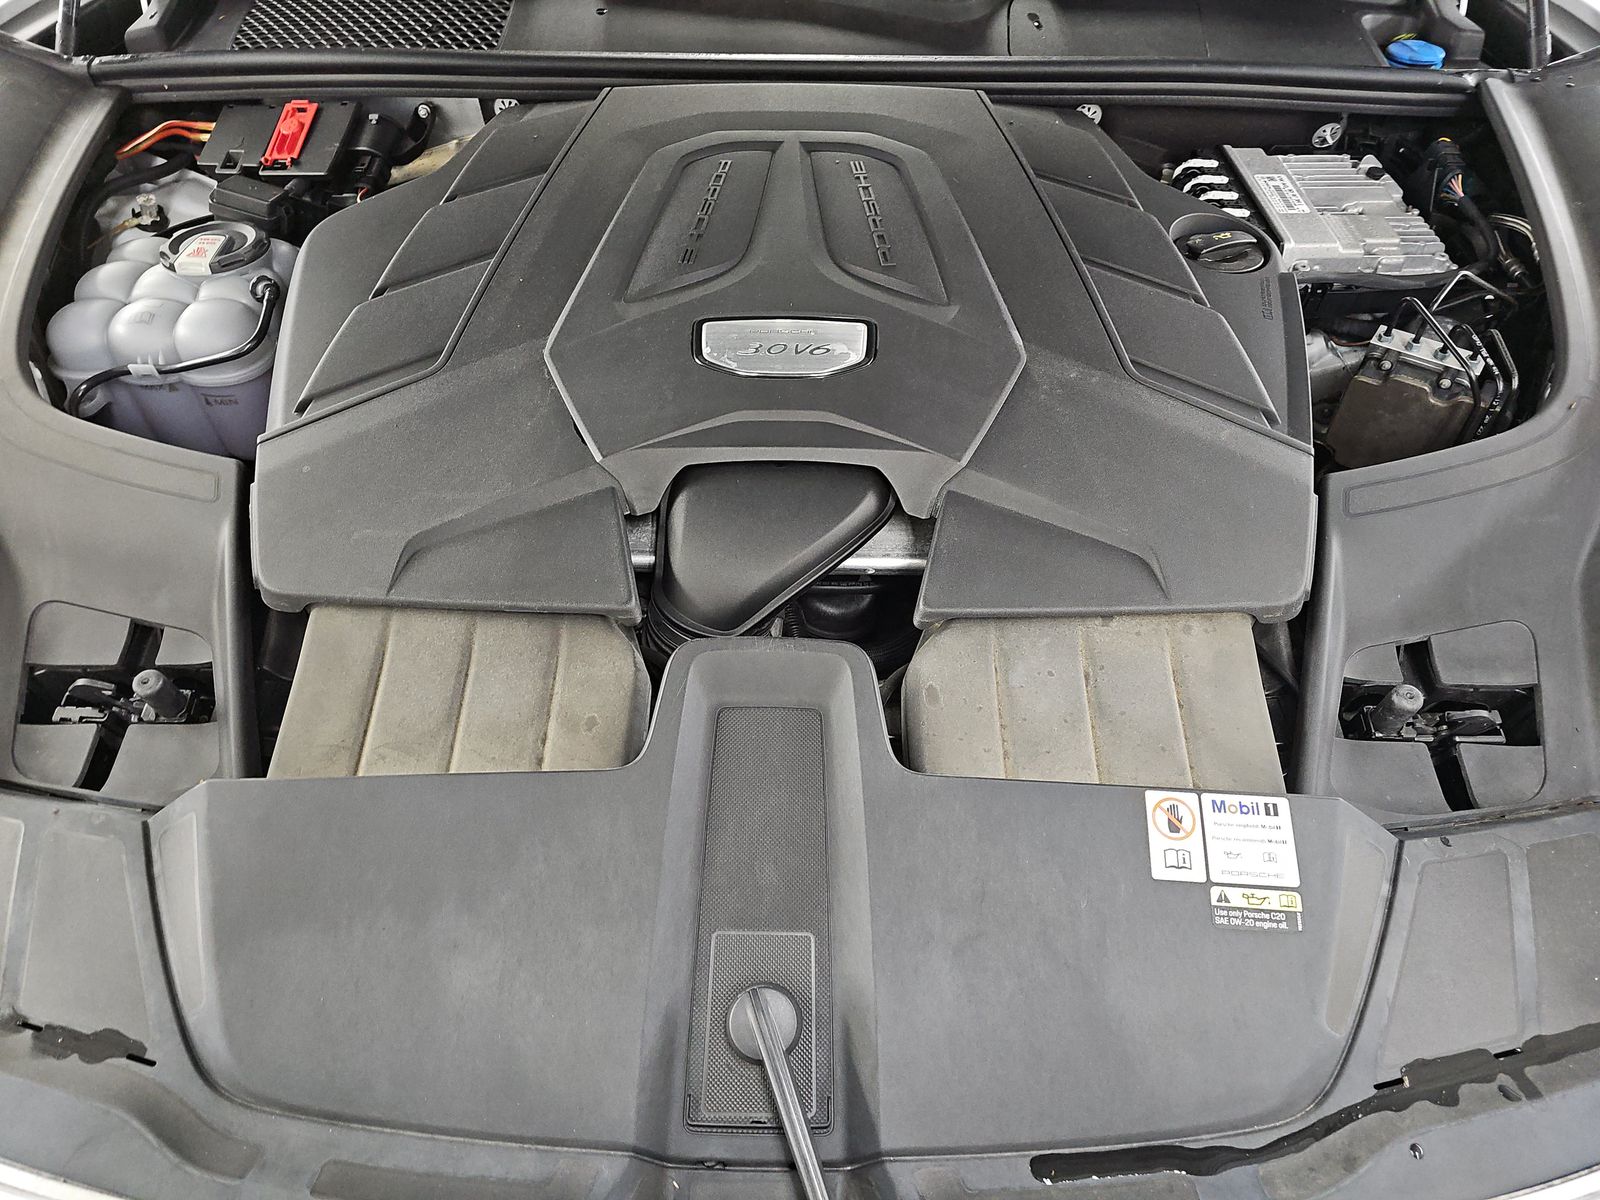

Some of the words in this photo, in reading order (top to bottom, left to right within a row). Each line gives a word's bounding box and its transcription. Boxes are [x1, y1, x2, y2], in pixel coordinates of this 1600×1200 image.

[678, 159, 732, 265] PORSCHE
[850, 160, 897, 266] PORSCHE
[1211, 799, 1260, 816] Mobil
[1264, 802, 1279, 817] 1
[1221, 869, 1286, 879] PORSCHE
[1214, 907, 1228, 917] Use
[1228, 909, 1243, 919] only
[1243, 910, 1270, 920] Porsche
[1270, 912, 1286, 921] C20
[1214, 916, 1229, 925] SAE
[1255, 920, 1278, 930] engine
[1278, 922, 1289, 930] oil.
